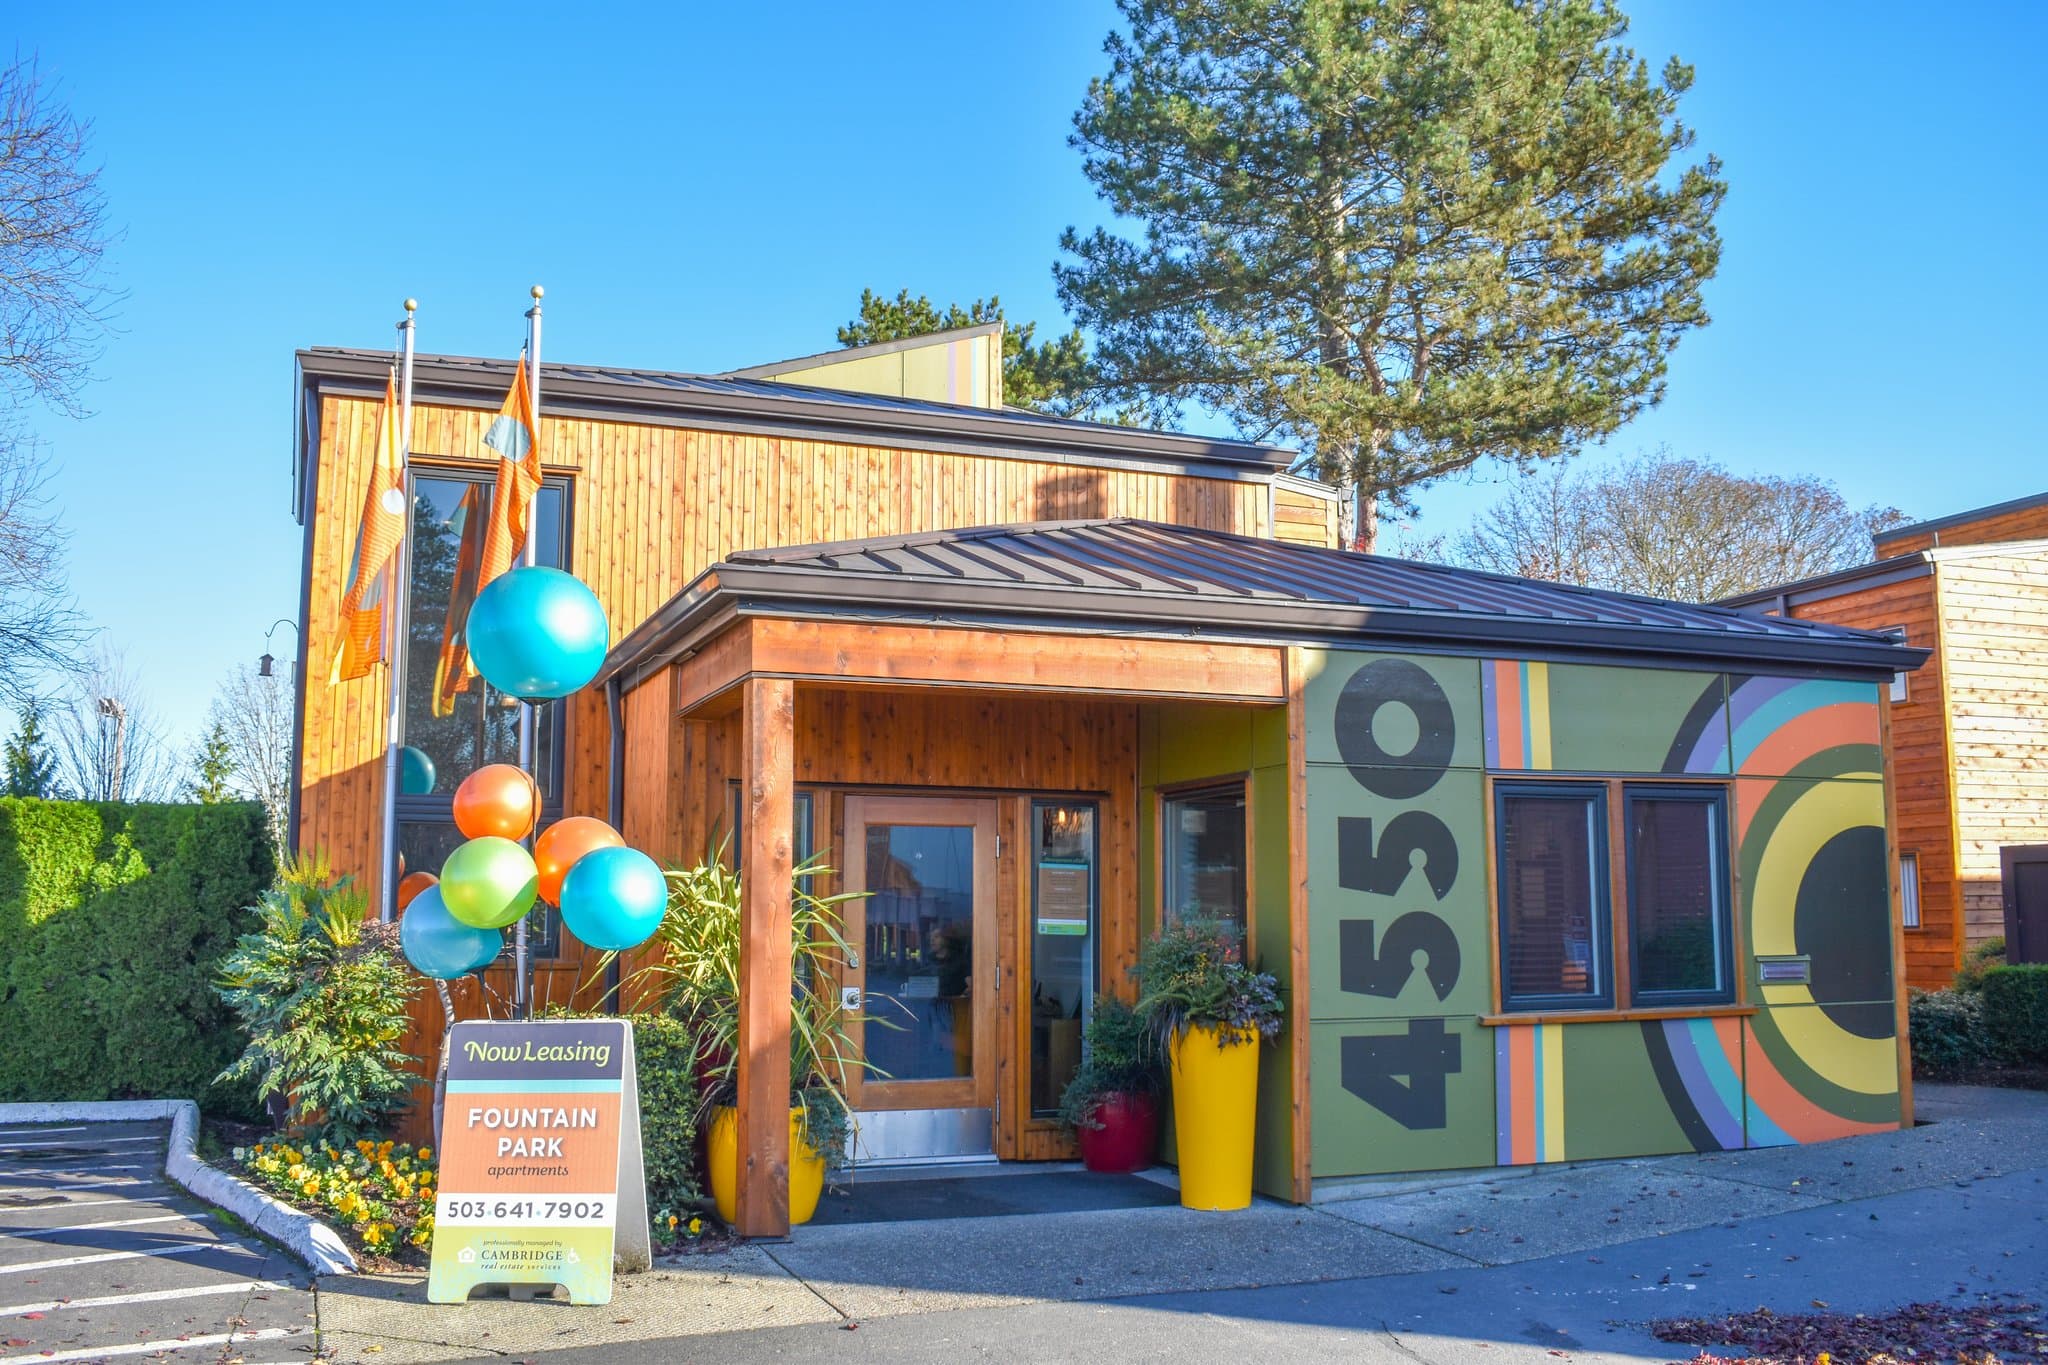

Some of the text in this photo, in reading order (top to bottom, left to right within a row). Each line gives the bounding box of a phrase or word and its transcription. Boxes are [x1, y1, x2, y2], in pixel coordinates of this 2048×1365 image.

[1334, 657, 1462, 1131] 4550
[463, 1040, 611, 1067] Now Leasing
[467, 1107, 597, 1129] FOUNTAIN
[497, 1137, 564, 1158] PARK
[487, 1165, 569, 1179] apartments
[483, 1239, 563, 1247] professionally managed by
[481, 1250, 563, 1261] CAMBRIDGE
[480, 1262, 498, 1270] real
[500, 1262, 524, 1270] estate
